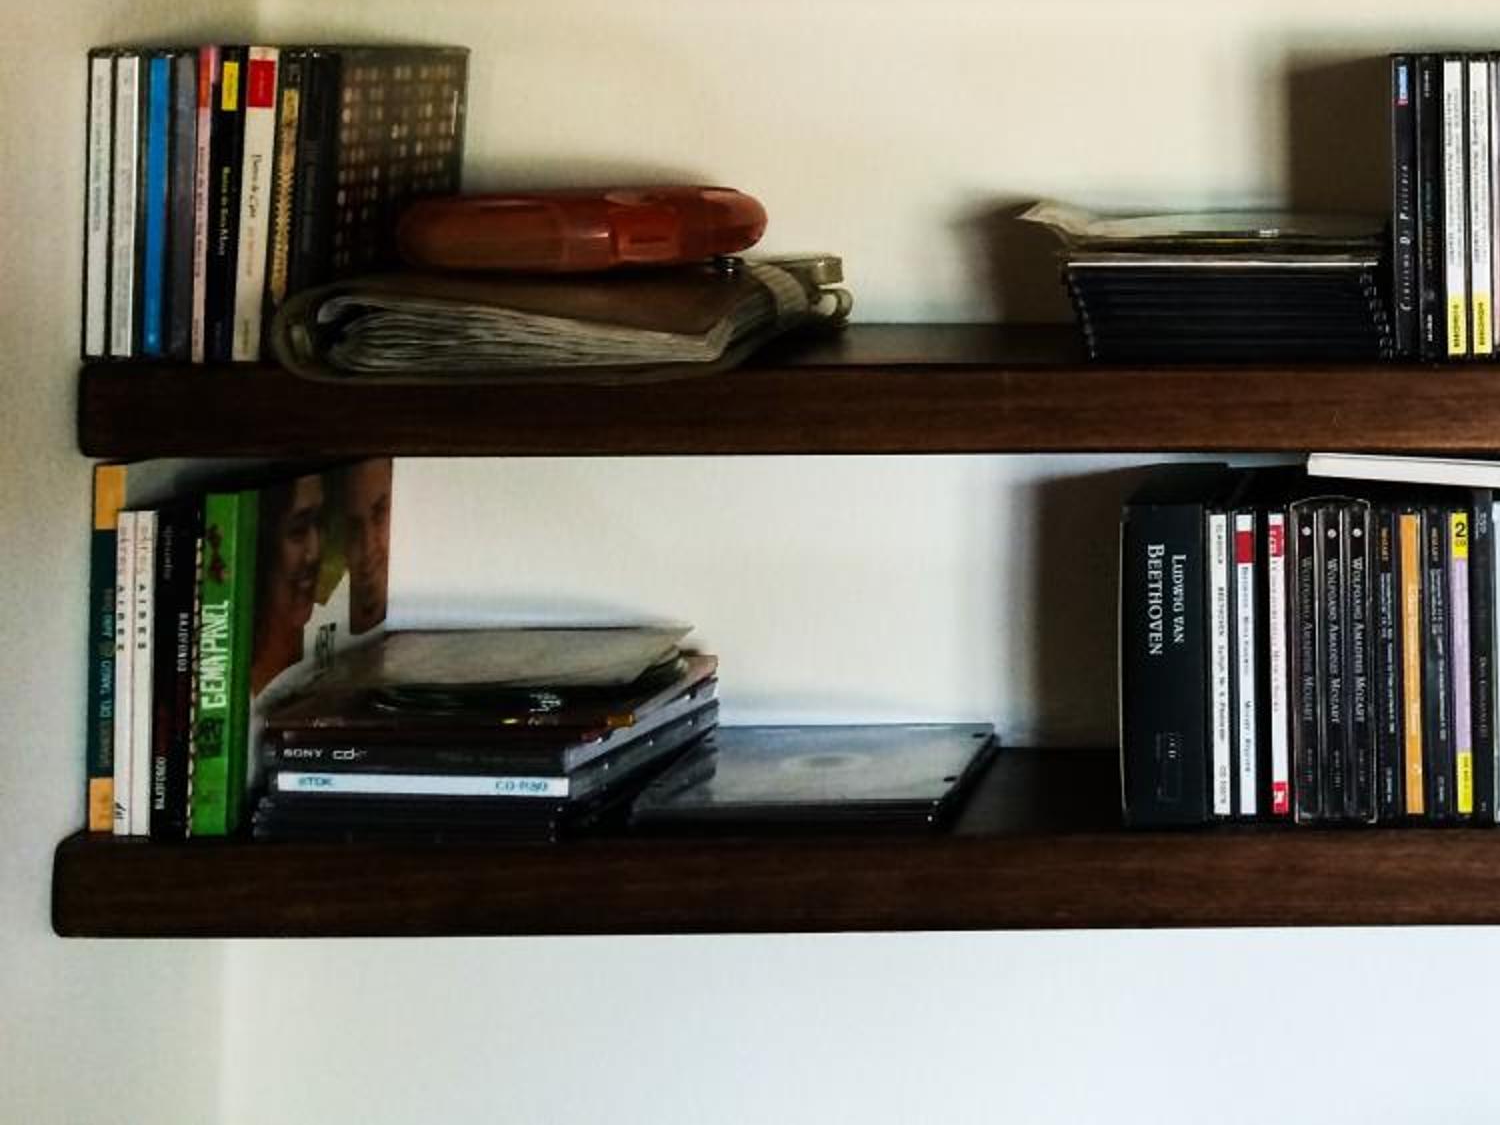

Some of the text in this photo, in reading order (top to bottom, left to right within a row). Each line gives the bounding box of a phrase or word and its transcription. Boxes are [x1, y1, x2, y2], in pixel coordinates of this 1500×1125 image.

[1454, 521, 1467, 538] 2
[1147, 544, 1164, 655] BEETHOVEN
[1172, 555, 1186, 643] LUDWIG VAN
[1327, 559, 1340, 723] WOLFGANG AMADEUS MOZART
[1352, 557, 1365, 722] WOLFGANG AMADEUS MOZART
[283, 748, 323, 758] SONY
